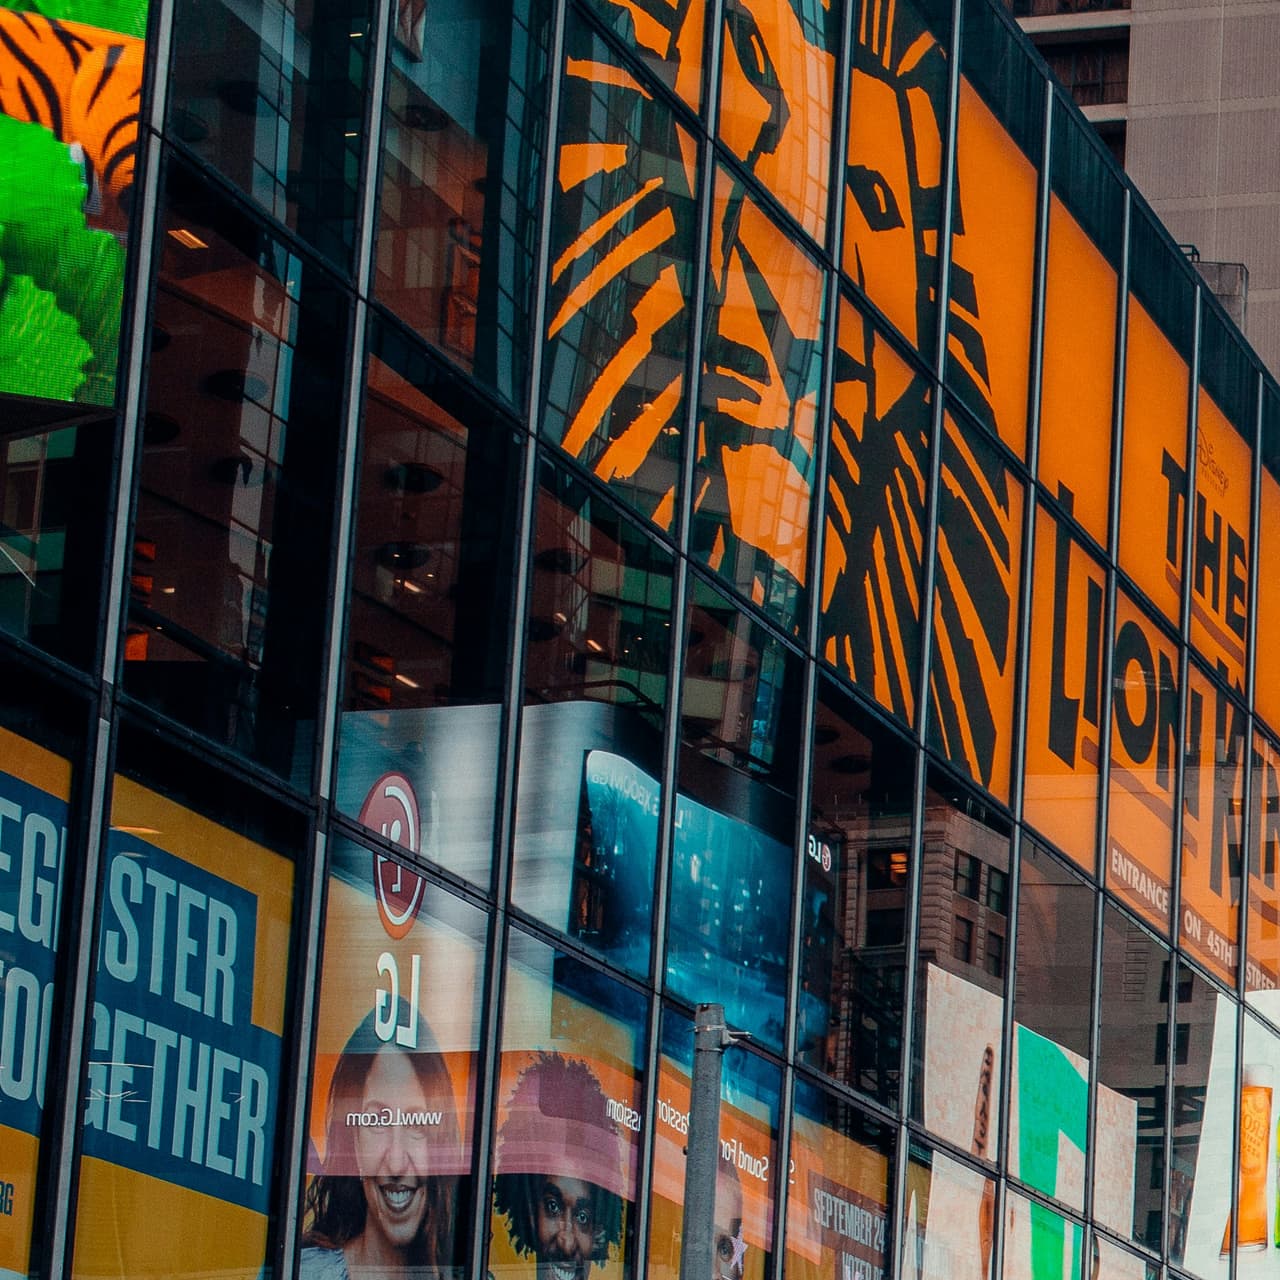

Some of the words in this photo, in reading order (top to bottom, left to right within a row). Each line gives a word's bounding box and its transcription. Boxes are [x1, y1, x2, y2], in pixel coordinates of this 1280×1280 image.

[1162, 447, 1247, 642] THE
[1048, 480, 1203, 821] LION
[0, 797, 239, 1026] EGISTER
[1112, 848, 1169, 915] ENTRANCE
[1184, 911, 1201, 941] ON
[1207, 929, 1233, 966] 45TH
[0, 965, 269, 1187] OGETHER
[814, 1187, 873, 1248] SEPTEMBER
[873, 1215, 885, 1249] 24
